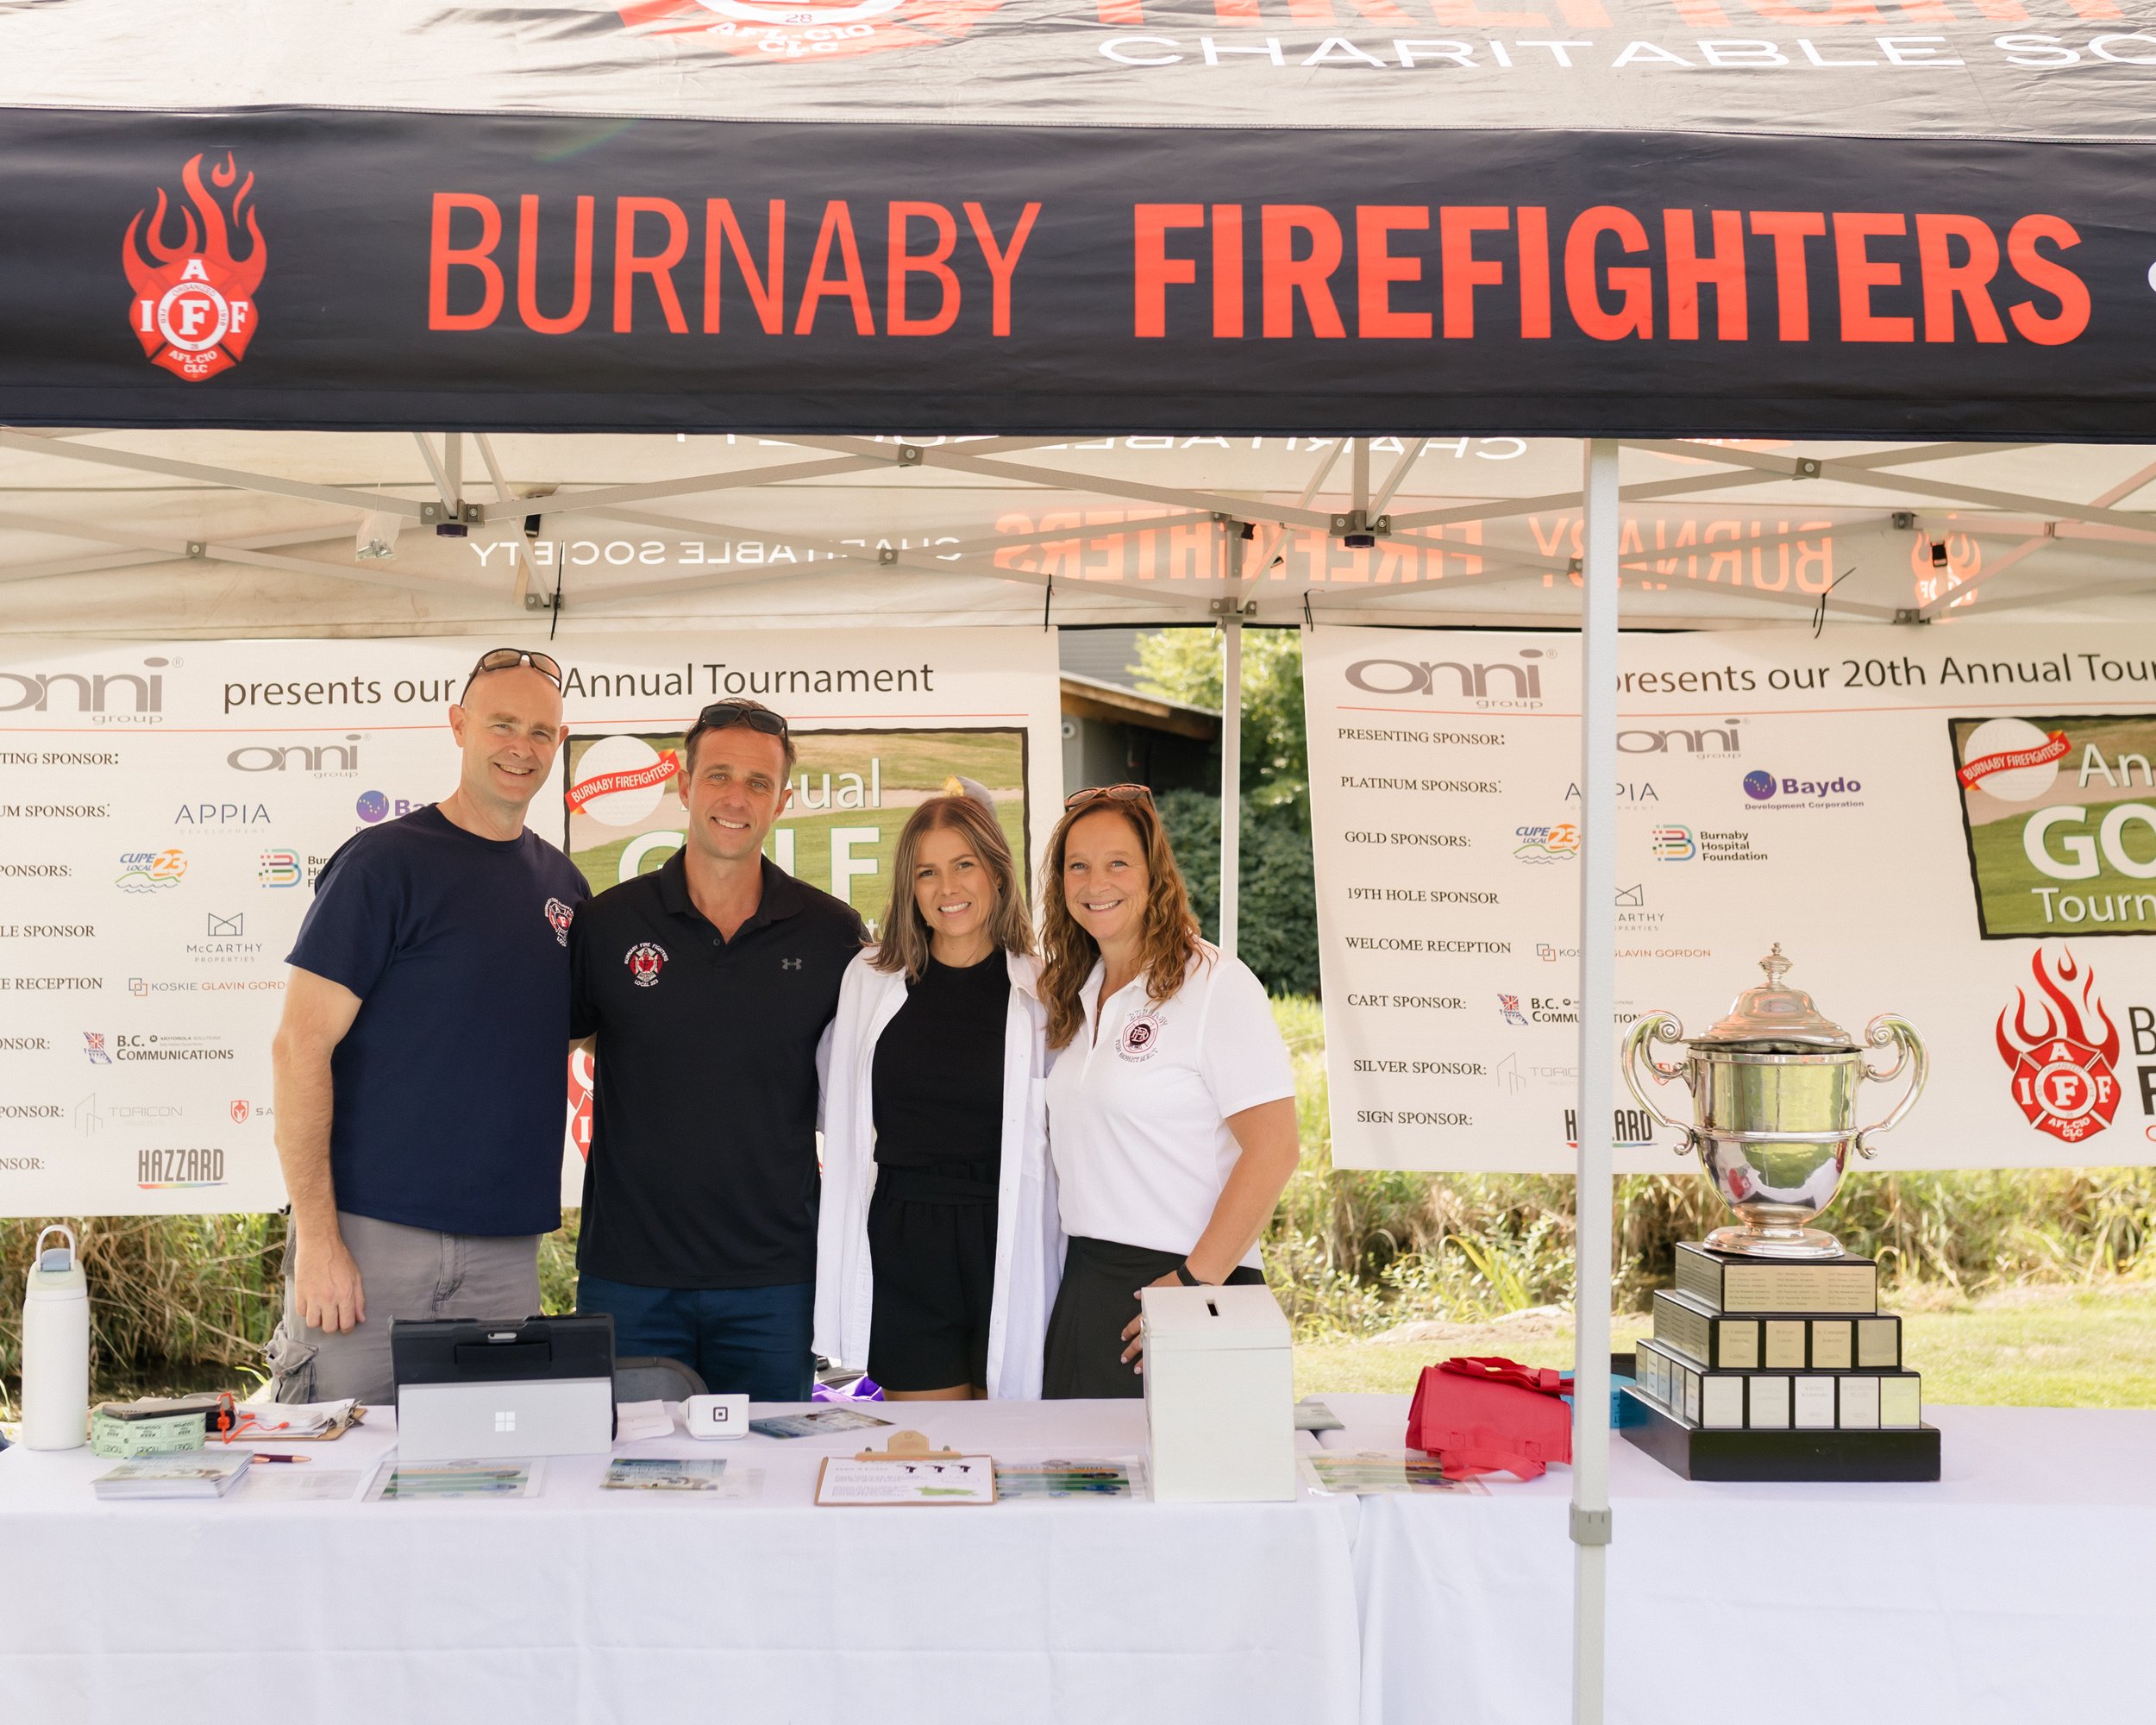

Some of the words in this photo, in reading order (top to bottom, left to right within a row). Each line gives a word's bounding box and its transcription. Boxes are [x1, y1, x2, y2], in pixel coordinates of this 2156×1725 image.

[786, 13, 813, 23] 28
[706, 21, 875, 41] AFL-CIO
[758, 39, 839, 54] CLC
[1098, 35, 1966, 67] CHARITABLE
[179, 259, 210, 281] A
[429, 192, 1042, 336] BURNABY
[1134, 203, 2092, 347] FIREFIGHTERS
[179, 299, 210, 336] F
[229, 301, 248, 333] F
[168, 349, 217, 364] AFL-CIO
[184, 364, 208, 373] CLC
[1344, 649, 1544, 699] onni
[1768, 664, 1830, 689] our
[1842, 656, 1926, 688] 20th
[1940, 653, 2071, 686] Annual
[224, 675, 381, 715] presents
[394, 677, 456, 703] our
[562, 662, 693, 698] Annual
[703, 663, 935, 695] Tournament
[1476, 699, 1544, 710] group
[92, 715, 163, 725] group
[1338, 727, 1429, 743] PRESENTING
[1433, 731, 1506, 746] SPONSOR:
[1617, 718, 1741, 753] onni
[42, 752, 119, 765] SPONSOR:
[227, 734, 362, 772] onni
[1963, 756, 2005, 781] BURNABY
[2006, 740, 2066, 767] FIREFIGHTERS
[314, 770, 359, 779] group
[570, 777, 614, 803] BURNABY
[615, 759, 675, 788] FIREFIGHTERS
[1341, 775, 1418, 791] PLATINUM
[1421, 779, 1502, 794] SPONSORS:
[1782, 777, 1862, 798] Baydo
[25, 803, 110, 818] SPONSORS:
[1745, 802, 1807, 811] Development
[1808, 800, 1865, 810] Corporation
[175, 804, 271, 825] APPIA
[1344, 831, 1388, 845] GOLD
[1391, 832, 1471, 848] SPONSORS:
[1515, 826, 1551, 837] CUPE
[1548, 825, 1580, 848] 23
[1701, 831, 1749, 842] Burnaby
[1702, 841, 1750, 852] Hospital
[120, 853, 157, 863] CUPE
[154, 853, 185, 875] 23
[1702, 851, 1768, 862] Foundation
[1347, 887, 1382, 901] 19TH
[1386, 888, 1427, 903] HOLE
[1431, 890, 1500, 905] SPONSOR
[23, 925, 96, 938] SPONSOR
[186, 943, 263, 954] McCARTHY
[1345, 937, 1423, 952] WELCOME
[1427, 938, 1512, 954] RECEPTION
[1655, 948, 1711, 957] GORDON
[16, 977, 103, 990] RECEPTION
[151, 982, 198, 991] KOSKIE
[201, 982, 246, 991] GLAVIN
[248, 981, 288, 990] GORD
[1347, 994, 1388, 1007] CART
[1393, 995, 1467, 1010] SPONSOR:
[1531, 998, 1559, 1010] B.C.
[117, 1035, 145, 1047] B.C.
[2048, 1042, 2074, 1062] A
[1353, 1058, 1409, 1074] SILVER
[1413, 1060, 1488, 1076] SPONSOR:
[2052, 1076, 2078, 1106] F
[108, 1106, 183, 1117] TORICON
[1357, 1110, 1394, 1124] SIGN
[1398, 1112, 1473, 1126] SPONSOR:
[2047, 1117, 2090, 1129] AFL-CIO
[2062, 1128, 2084, 1138] CLC
[138, 1149, 225, 1182] HAZZARD
